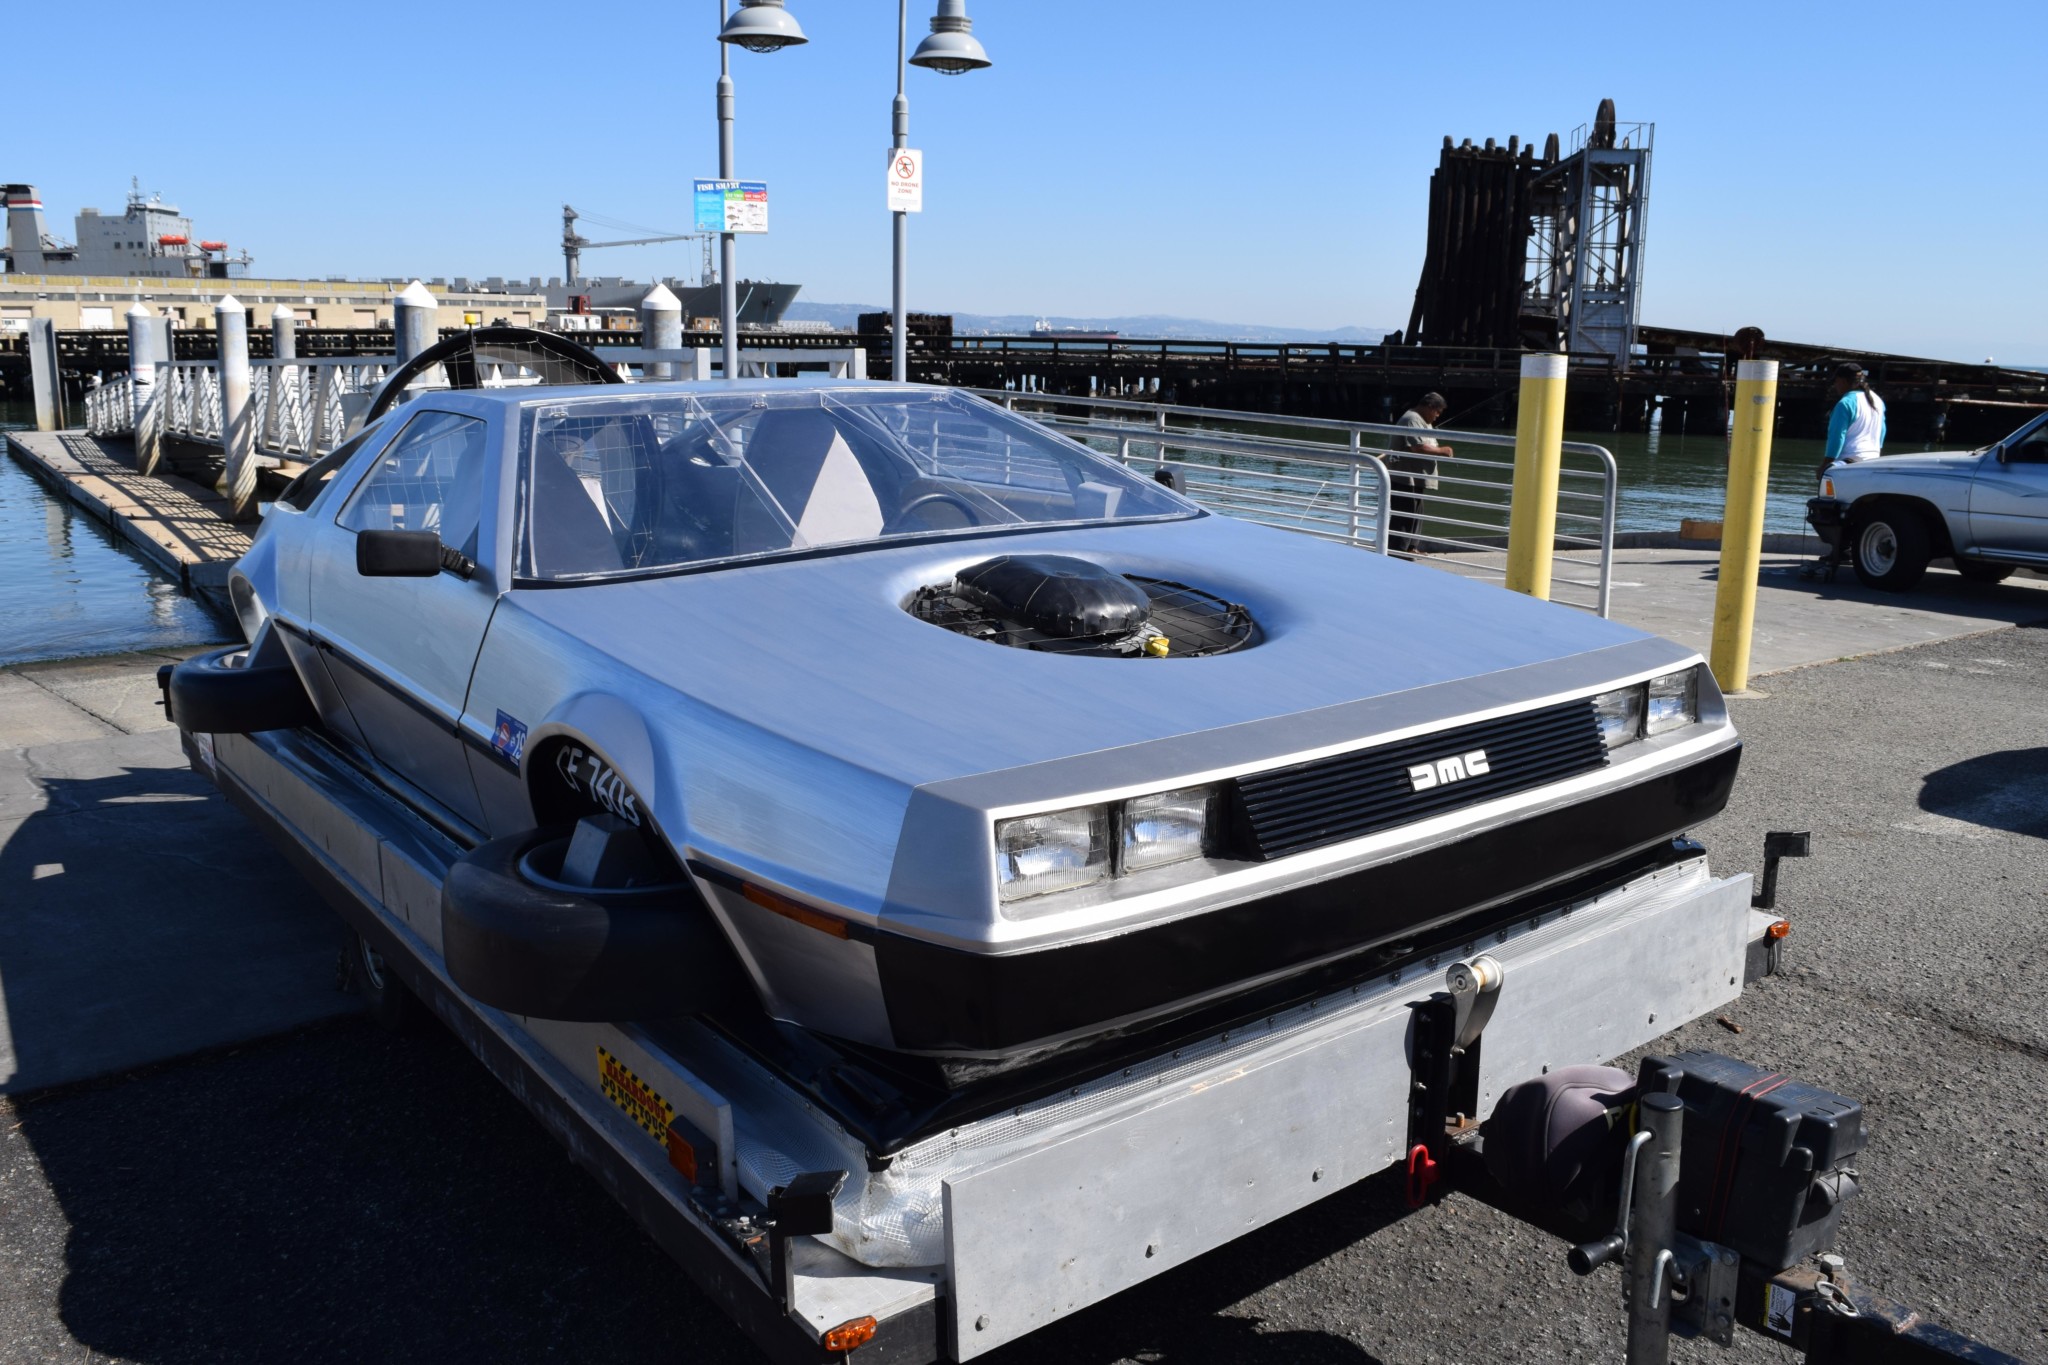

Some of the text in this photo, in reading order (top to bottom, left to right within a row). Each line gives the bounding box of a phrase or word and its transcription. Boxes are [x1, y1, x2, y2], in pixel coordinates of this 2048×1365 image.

[697, 183, 714, 191] FISH
[715, 182, 740, 190] SMART
[556, 745, 583, 792] CF
[602, 1072, 616, 1093] DO
[617, 1086, 637, 1111] NOT
